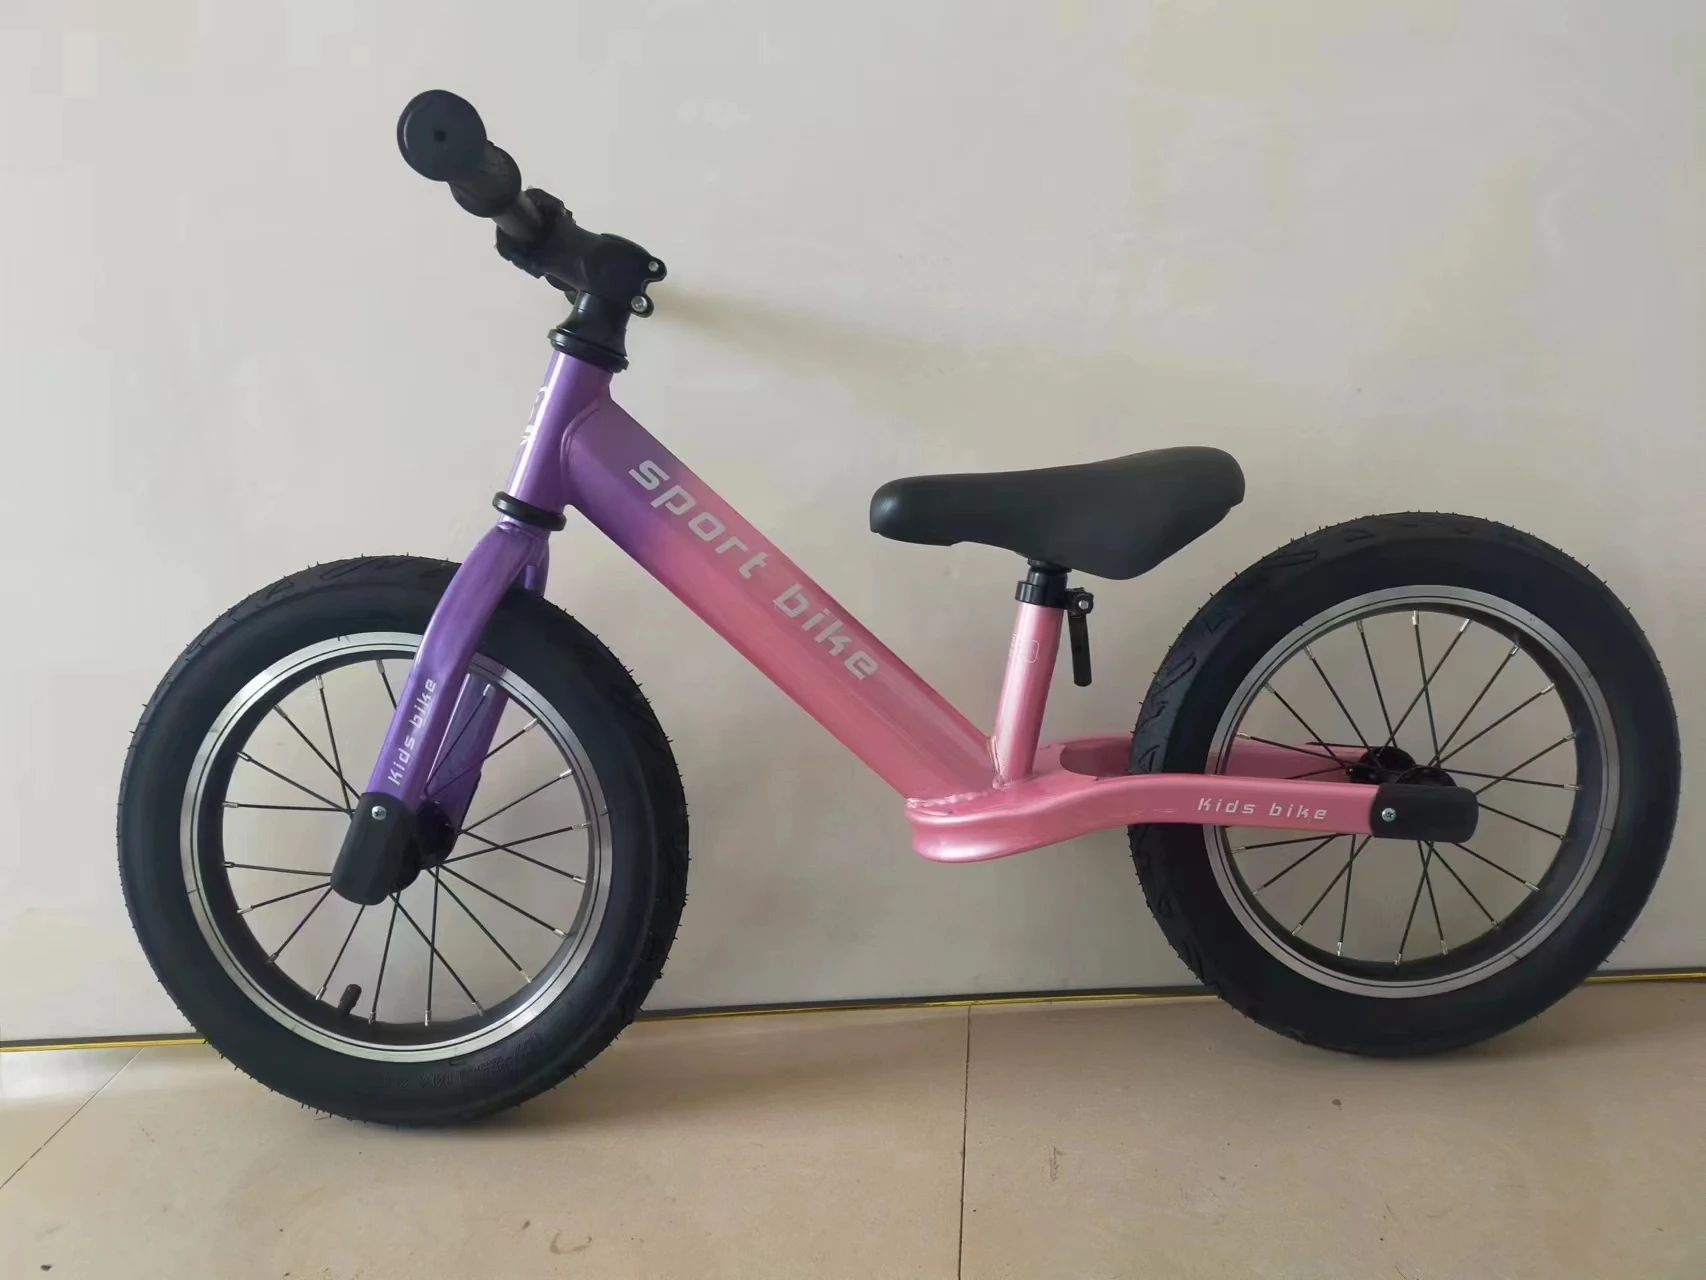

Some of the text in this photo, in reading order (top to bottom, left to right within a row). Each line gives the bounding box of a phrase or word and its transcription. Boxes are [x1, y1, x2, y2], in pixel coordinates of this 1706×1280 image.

[628, 460, 879, 680] sport bike
[409, 678, 437, 729] bike
[1269, 802, 1327, 820] bike
